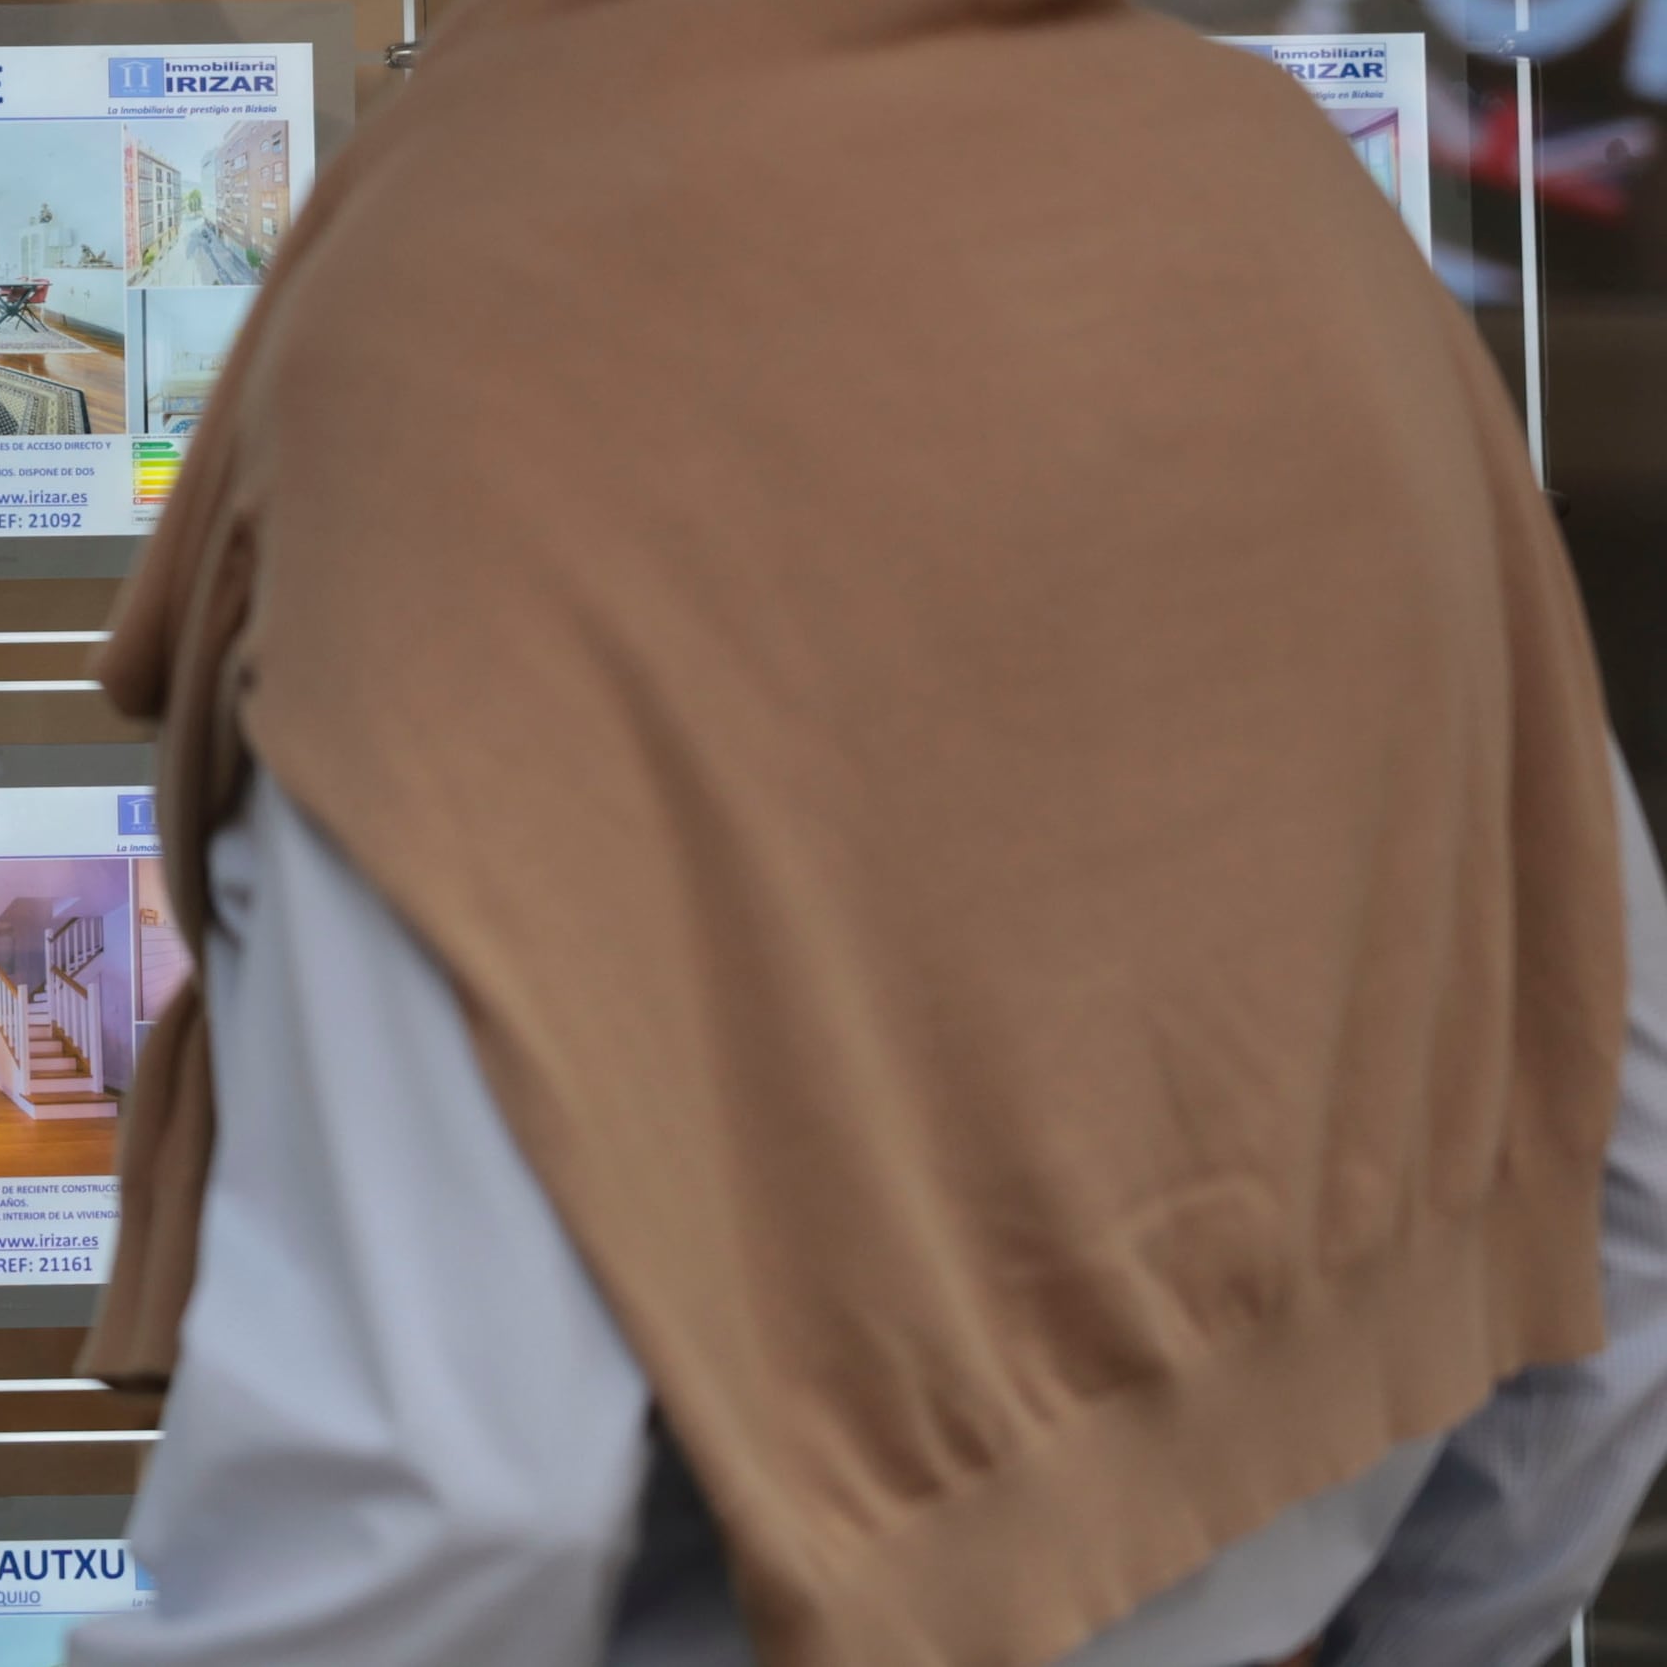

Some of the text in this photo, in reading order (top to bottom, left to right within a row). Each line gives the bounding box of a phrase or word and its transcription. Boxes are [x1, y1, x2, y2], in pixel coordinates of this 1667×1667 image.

[1274, 46, 1385, 60] Inmobiliaria
[165, 60, 276, 72] Inmobiliaria
[1284, 62, 1384, 80] RIZAR
[165, 75, 274, 93] IRIZAR
[27, 512, 81, 528] 21092
[38, 1255, 92, 1272] 21161
